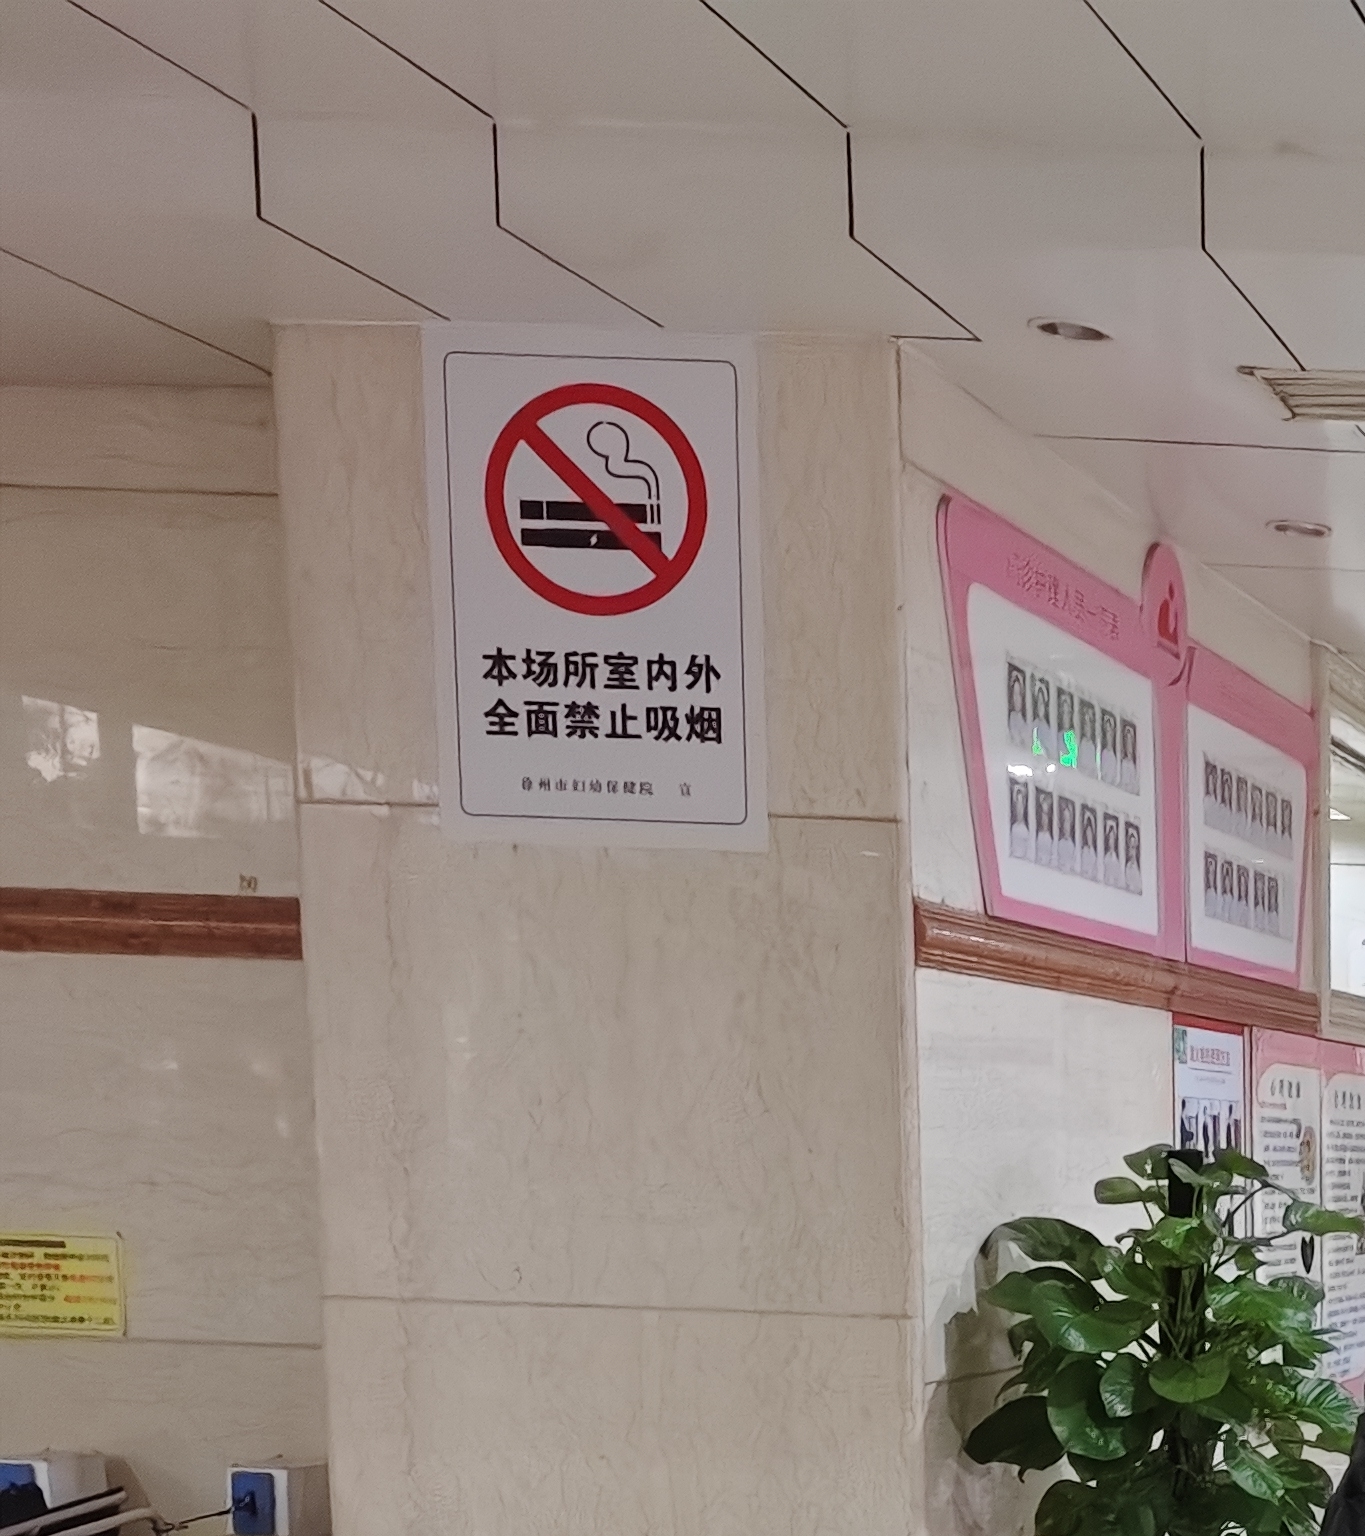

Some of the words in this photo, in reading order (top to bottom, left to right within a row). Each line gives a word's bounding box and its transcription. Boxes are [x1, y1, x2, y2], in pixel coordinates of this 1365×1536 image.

[482, 647, 721, 694] 本场所室内外
[484, 698, 722, 744] 全面禁止吸烟
